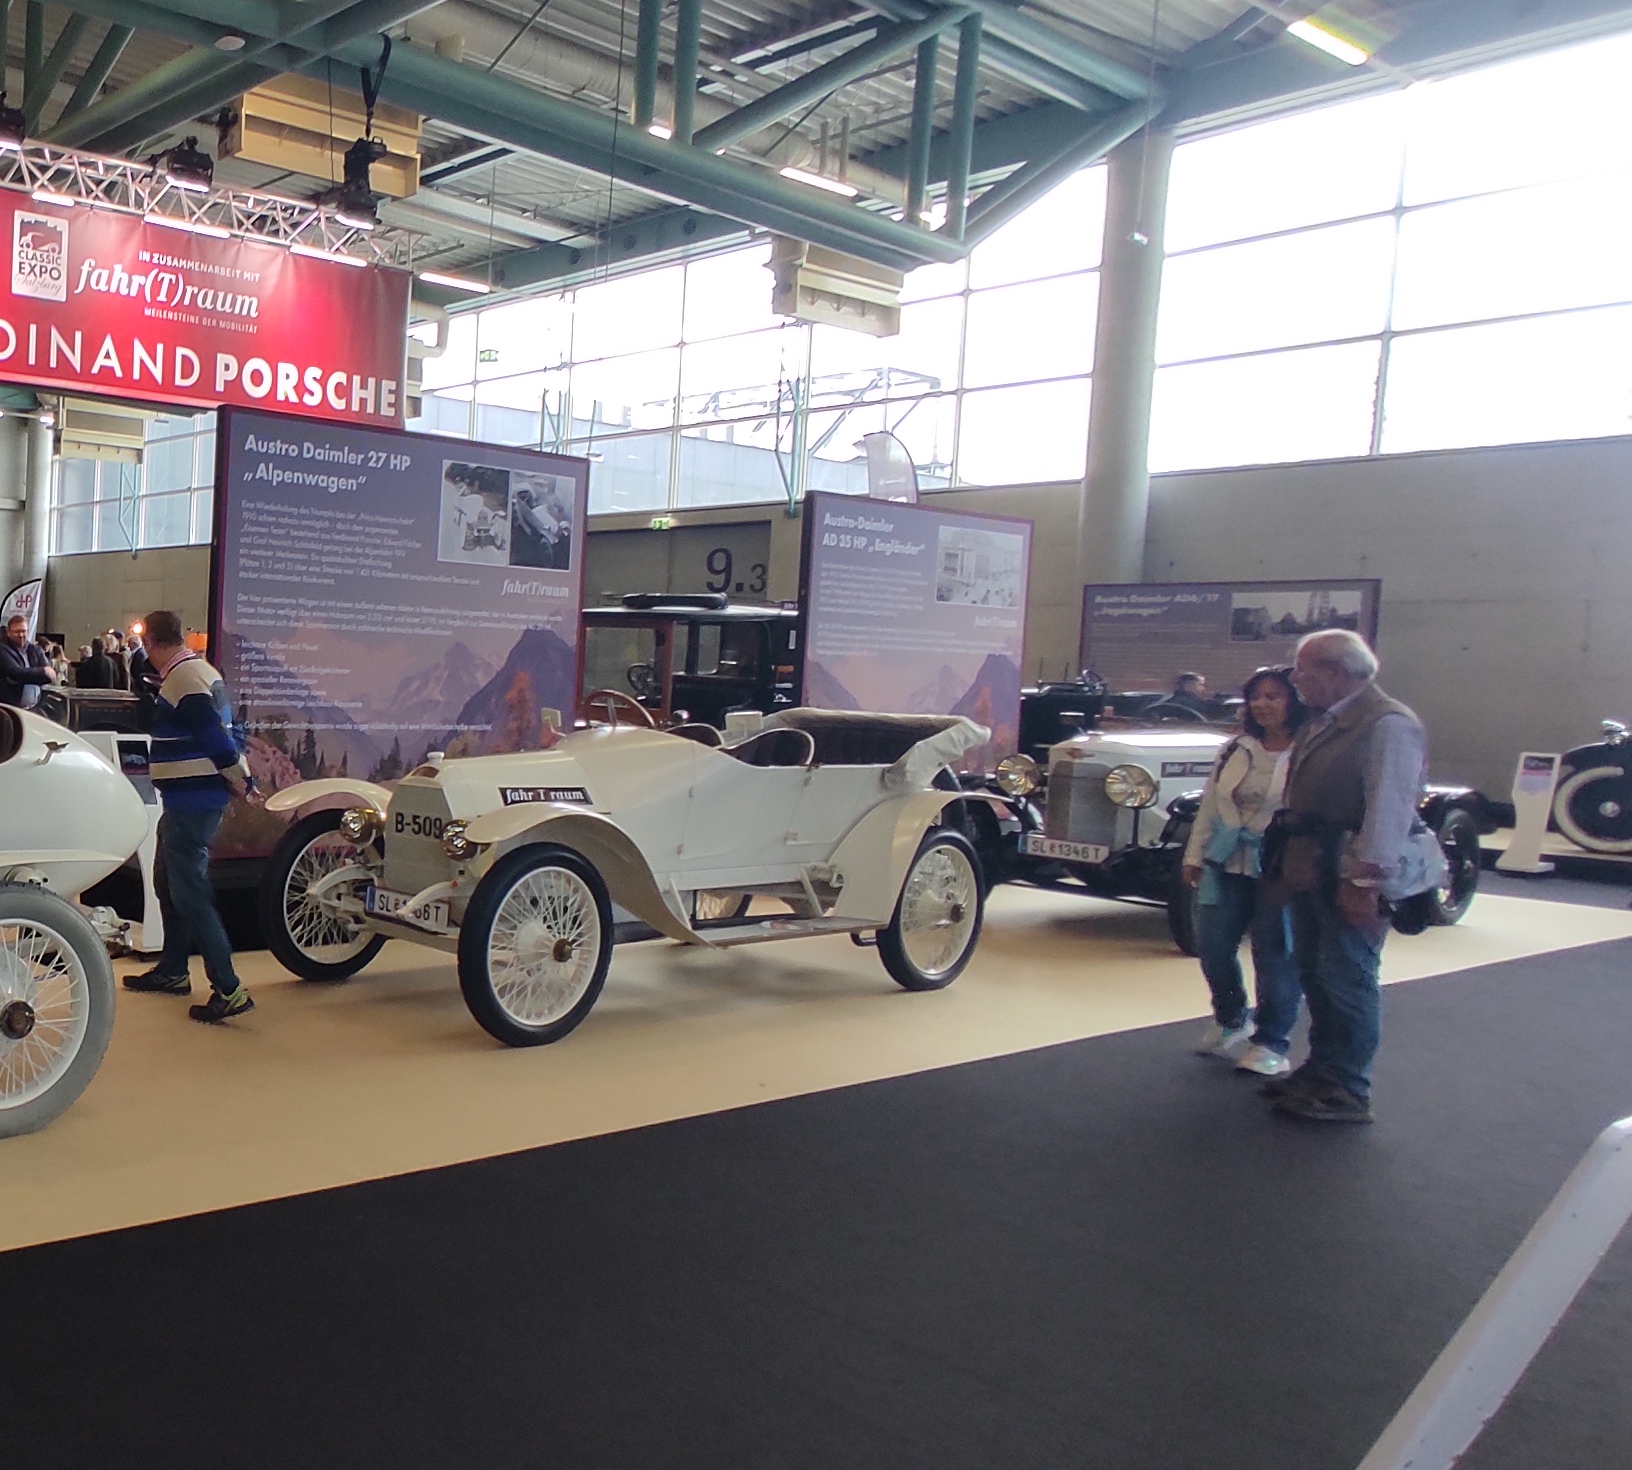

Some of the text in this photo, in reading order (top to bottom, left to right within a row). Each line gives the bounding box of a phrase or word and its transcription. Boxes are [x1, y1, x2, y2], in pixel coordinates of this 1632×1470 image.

[18, 249, 62, 266] CLASSIC
[18, 261, 62, 281] EXPO
[138, 250, 261, 283] IN ZUSAMMENARBEIT MIT
[74, 258, 259, 318] fahr(T)raum
[144, 306, 258, 334] MEILENSTEINE DER MOBILITÄT
[215, 352, 397, 417] PORSCHE
[244, 434, 411, 471] Austro Daimler 27 HP
[823, 512, 895, 533] Austro-Daimler
[822, 532, 838, 547] AD
[839, 534, 851, 548] 35
[853, 535, 868, 550] HP
[706, 547, 767, 593] 9.3
[501, 579, 569, 597] fahr(T)raum
[505, 788, 584, 804] fahr T raum
[394, 812, 443, 839] B-509
[1031, 840, 1047, 854] SL
[1093, 847, 1101, 860] T
[378, 894, 391, 912] SL
[434, 905, 441, 923] T
